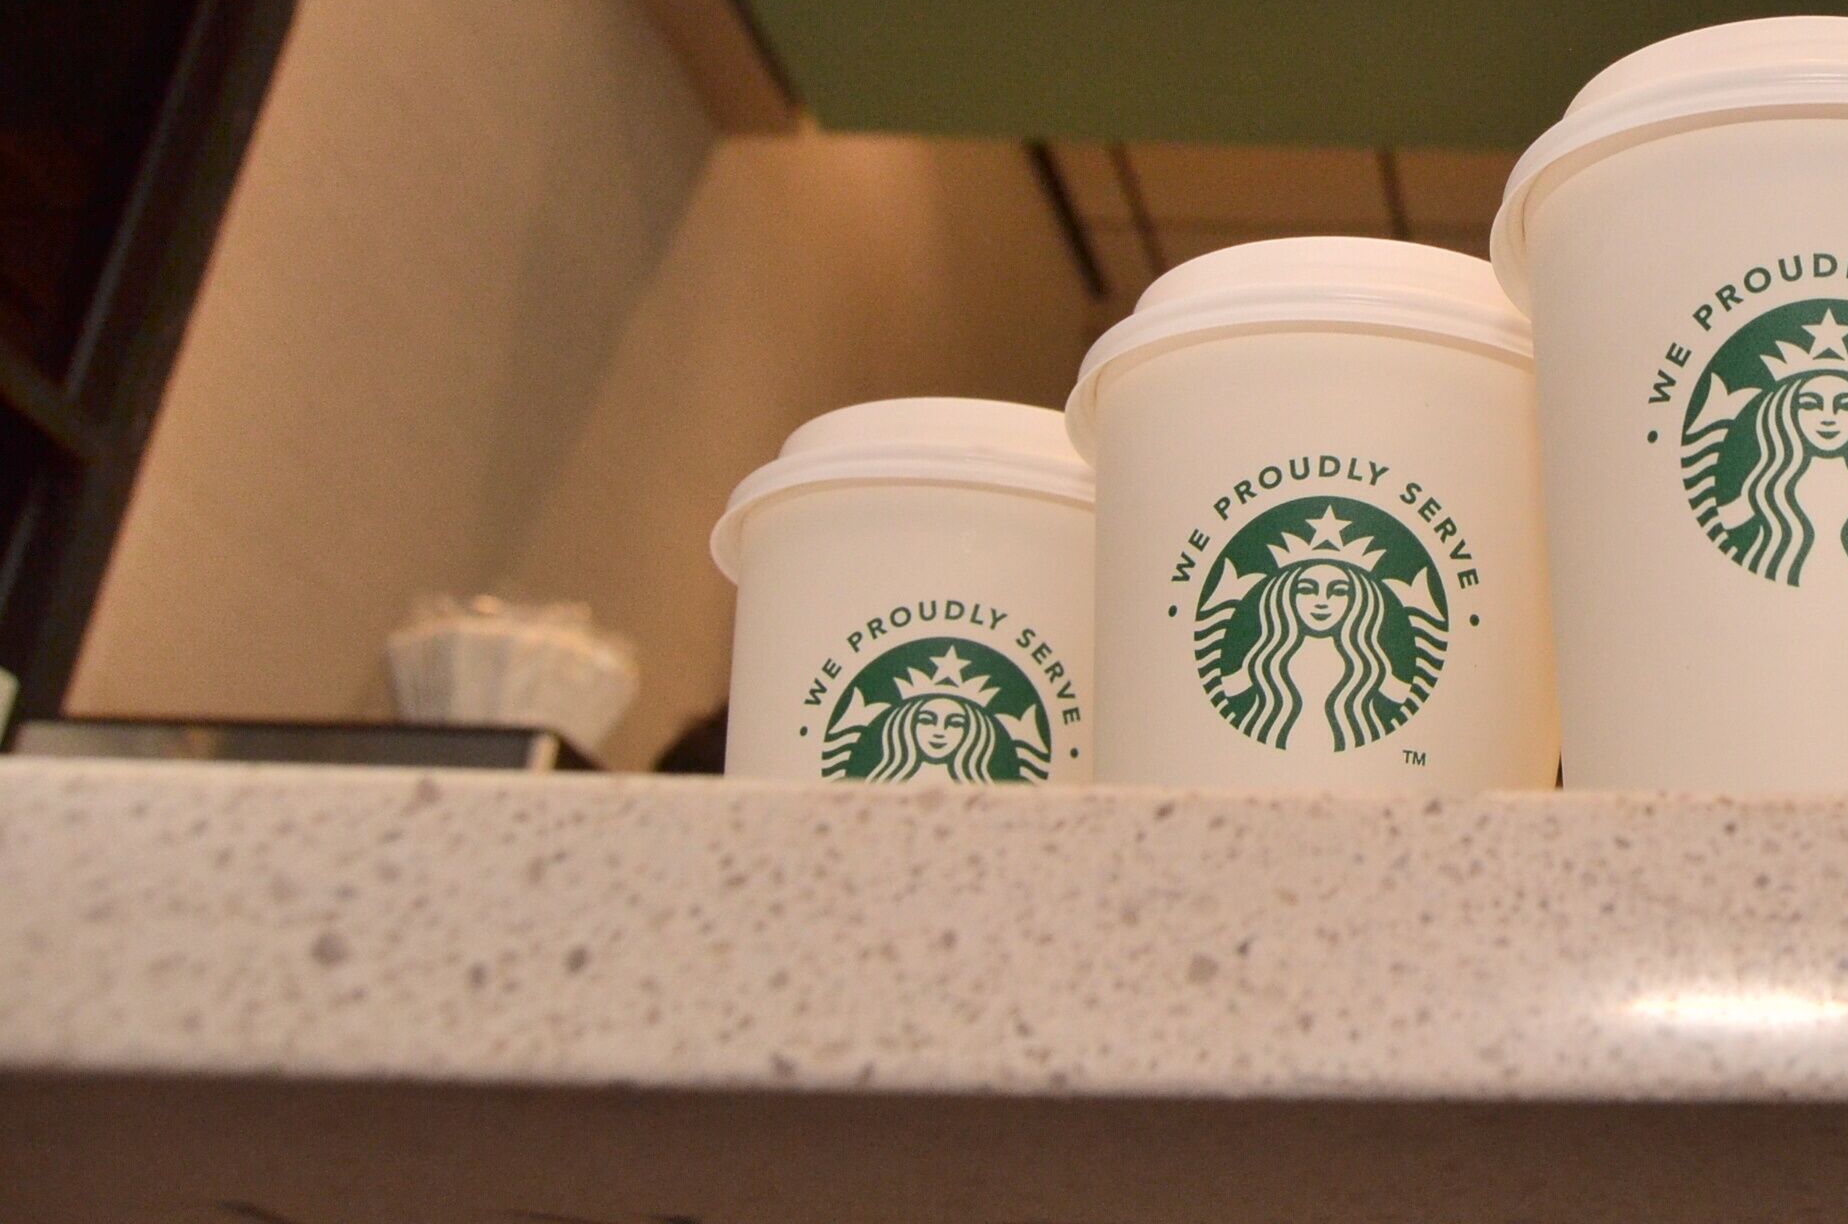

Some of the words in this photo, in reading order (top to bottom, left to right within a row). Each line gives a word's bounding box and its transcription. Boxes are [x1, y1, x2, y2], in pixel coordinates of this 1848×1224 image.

[1649, 343, 1691, 407] WE
[1170, 527, 1211, 585] WE
[1212, 454, 1389, 521] PROUDLY
[1400, 481, 1480, 591] SERVE
[803, 657, 842, 708] WE
[846, 600, 1008, 654] PROUDLY
[1016, 628, 1081, 725] SERVE
[1402, 748, 1428, 767] TM
